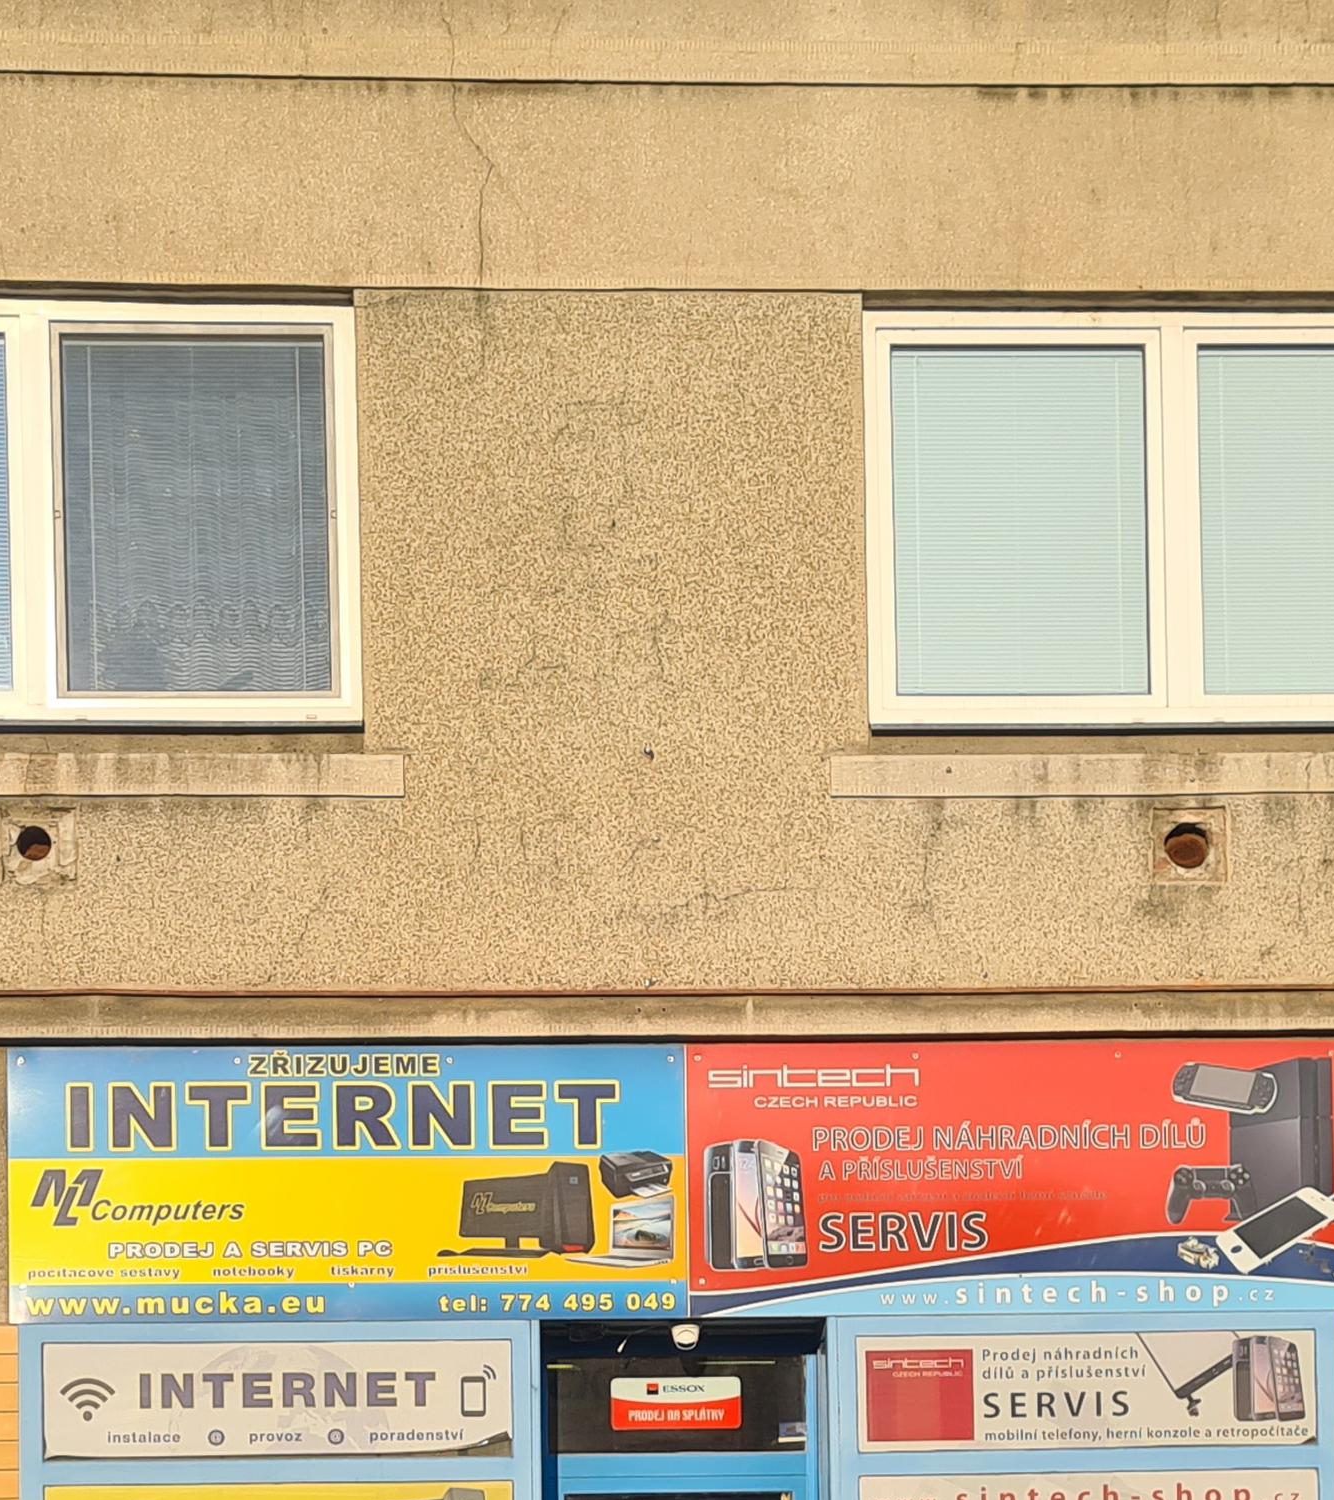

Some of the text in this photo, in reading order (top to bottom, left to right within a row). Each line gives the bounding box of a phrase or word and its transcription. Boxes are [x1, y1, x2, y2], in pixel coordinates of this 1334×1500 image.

[247, 1051, 440, 1077] ZŘIZUJEME
[708, 1064, 920, 1090] sintech
[754, 1095, 919, 1108] CZECH REPUBLIC
[66, 1080, 618, 1152] INTERNET
[812, 1117, 1207, 1152] PRODEJ NÁHRADNÍCH DÍLŮ
[818, 1154, 1025, 1181] A PŘÍSLUŠENSTVÍ
[90, 1199, 245, 1227] Computers
[818, 1210, 989, 1253] SERVIS
[108, 1240, 393, 1259] PRODEJ A SERVIS PC
[121, 1265, 295, 1280] sestavy notebooky
[26, 1290, 677, 1317] www.mucka.eu tel: 774 495 049
[880, 1280, 1276, 1307] www.sintech-shop.cz
[873, 1357, 964, 1369] sintech
[982, 1346, 1139, 1364] Prodej náhradních
[982, 1363, 1147, 1382] dílů a příslušenství
[139, 1371, 437, 1410] INTERNET
[662, 1384, 706, 1394] ESSOX
[628, 1408, 665, 1422] PRODEJ
[682, 1406, 725, 1421] SPLÁTKY
[983, 1390, 1130, 1419] SERVIS
[107, 1427, 465, 1446] instalace provoz poradenství
[984, 1424, 1310, 1443] mobilní telefony, herní konzole a retropočítače
